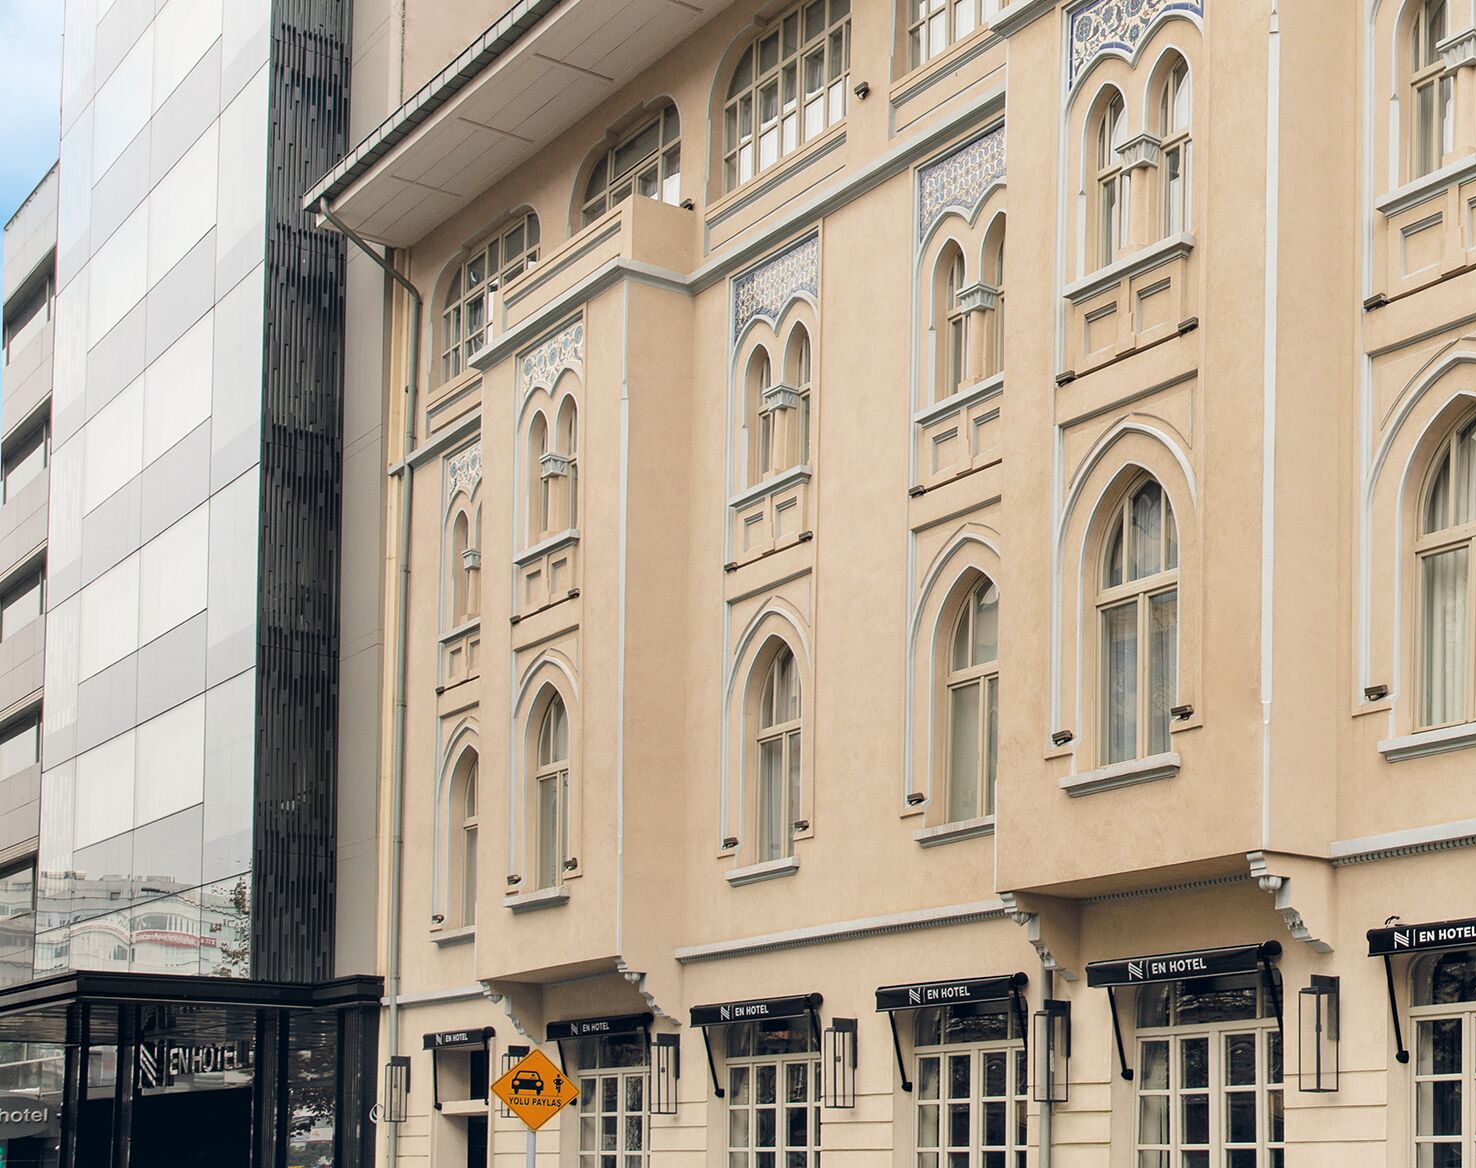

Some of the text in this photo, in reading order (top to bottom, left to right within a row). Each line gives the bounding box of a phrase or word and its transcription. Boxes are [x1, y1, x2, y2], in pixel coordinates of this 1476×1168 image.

[1419, 930, 1435, 943] EN
[1151, 961, 1167, 975] EN
[1169, 957, 1207, 972] HOTEL
[927, 989, 939, 1000] EN
[941, 985, 970, 999] HOTEL
[735, 1007, 744, 1017] EN
[746, 1004, 768, 1015] HOTEL
[582, 1023, 591, 1032] EN
[592, 1022, 609, 1031] HOTEL
[452, 1033, 468, 1041] HOTEL
[170, 1047, 189, 1075] EN
[191, 1044, 242, 1073] HOTEL
[509, 1097, 530, 1105] YOLU
